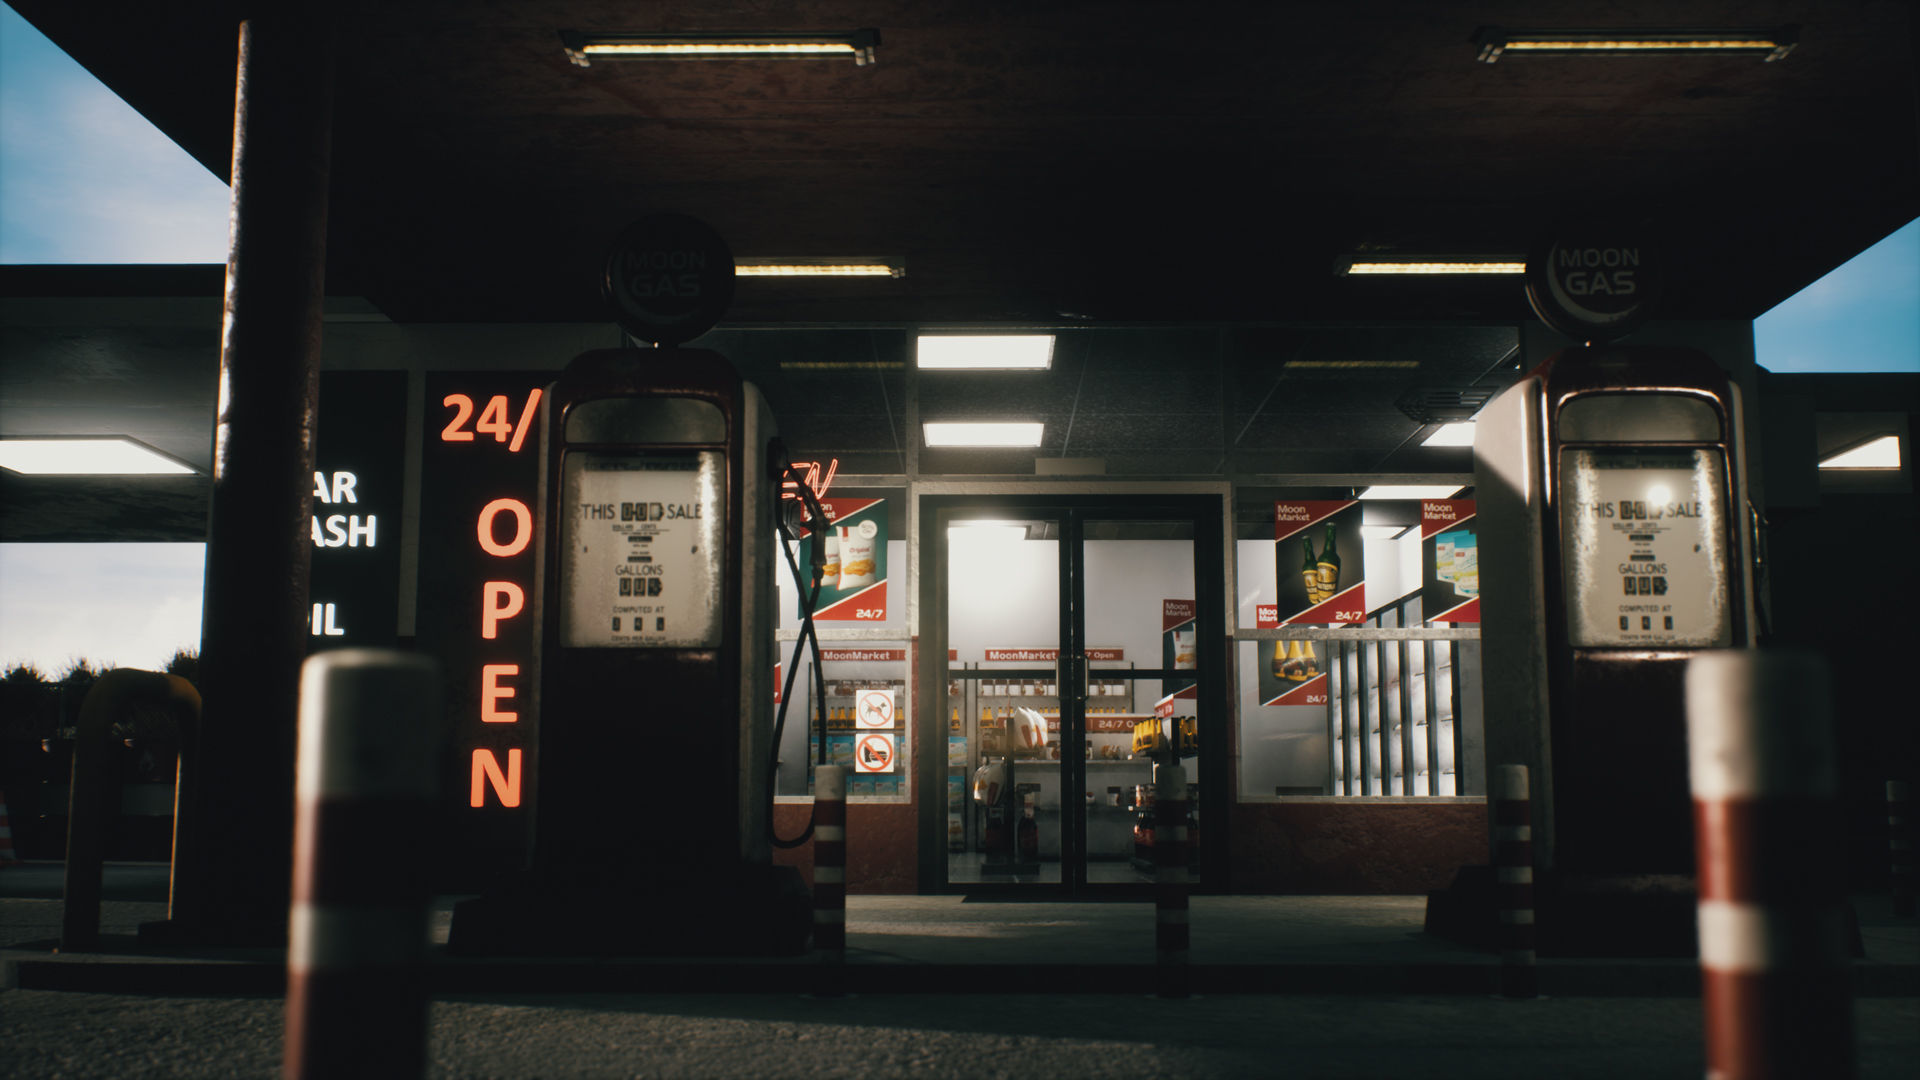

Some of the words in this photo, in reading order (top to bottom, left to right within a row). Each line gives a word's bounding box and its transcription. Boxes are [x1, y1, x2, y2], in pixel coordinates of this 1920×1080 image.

[627, 251, 705, 270] MOON
[1560, 248, 1640, 268] MOON
[631, 273, 702, 297] GAS
[1565, 271, 1637, 296] GAS
[441, 388, 543, 453] 24/
[581, 503, 615, 520] THIS
[667, 503, 703, 520] SALE
[1278, 504, 1306, 514] Moon
[1424, 502, 1453, 512] Moon
[1667, 502, 1703, 518] SALE
[1278, 513, 1310, 522] Market
[1424, 511, 1457, 521] Market
[615, 564, 664, 575] GALLONS
[1618, 563, 1668, 574] GALLONS
[1166, 602, 1189, 610] Moon
[308, 602, 346, 636] IL
[856, 609, 884, 619] 24/7
[1335, 611, 1362, 621] 24/7
[823, 651, 890, 660] MoonMarket
[989, 651, 1056, 660] MoonMarket
[1306, 695, 1328, 704] 24/7
[1098, 719, 1124, 728] 24/7
